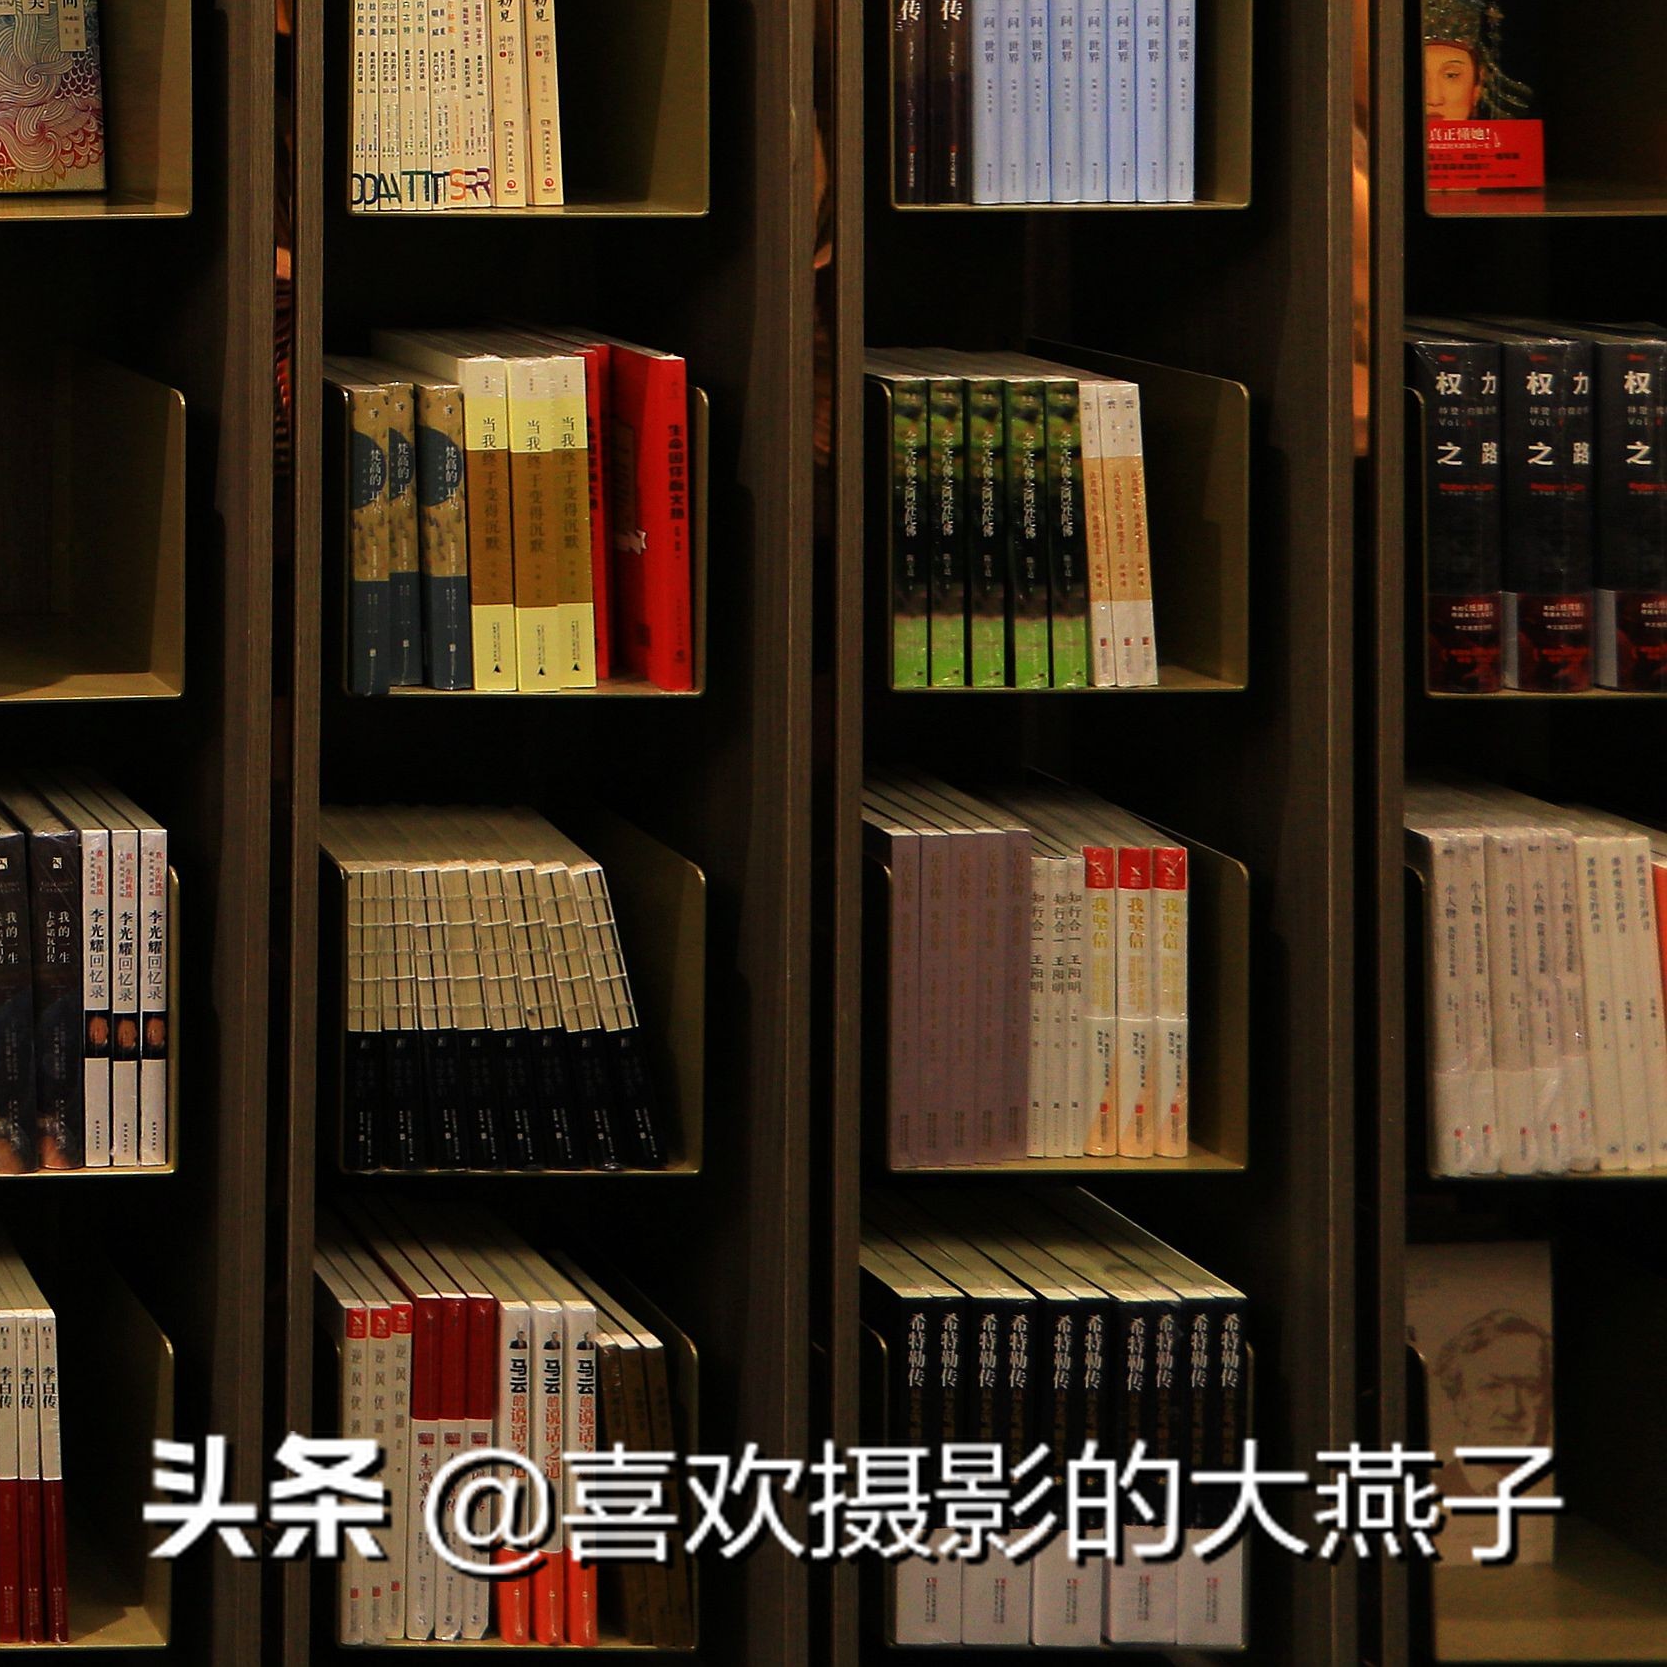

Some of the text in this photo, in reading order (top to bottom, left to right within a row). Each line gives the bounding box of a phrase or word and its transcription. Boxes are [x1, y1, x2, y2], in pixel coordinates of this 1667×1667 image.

[6, 912, 19, 964] 我的一生
[58, 910, 71, 964] 我的一生
[89, 909, 105, 998] 李光耀回忆录
[118, 911, 133, 1001] 李光耀回忆录
[147, 909, 162, 1000] 李光耀回忆录
[1068, 891, 1082, 994] 知行合一 王阳明
[1092, 898, 1109, 948] 我坚信
[1128, 898, 1144, 948] 我坚信
[908, 1312, 926, 1387] 希特勒传
[1010, 1313, 1029, 1388] 希特勒传
[1221, 1312, 1240, 1387] 希特勒传
[0, 1366, 12, 1409] 李白传
[21, 1366, 35, 1409] 李白传
